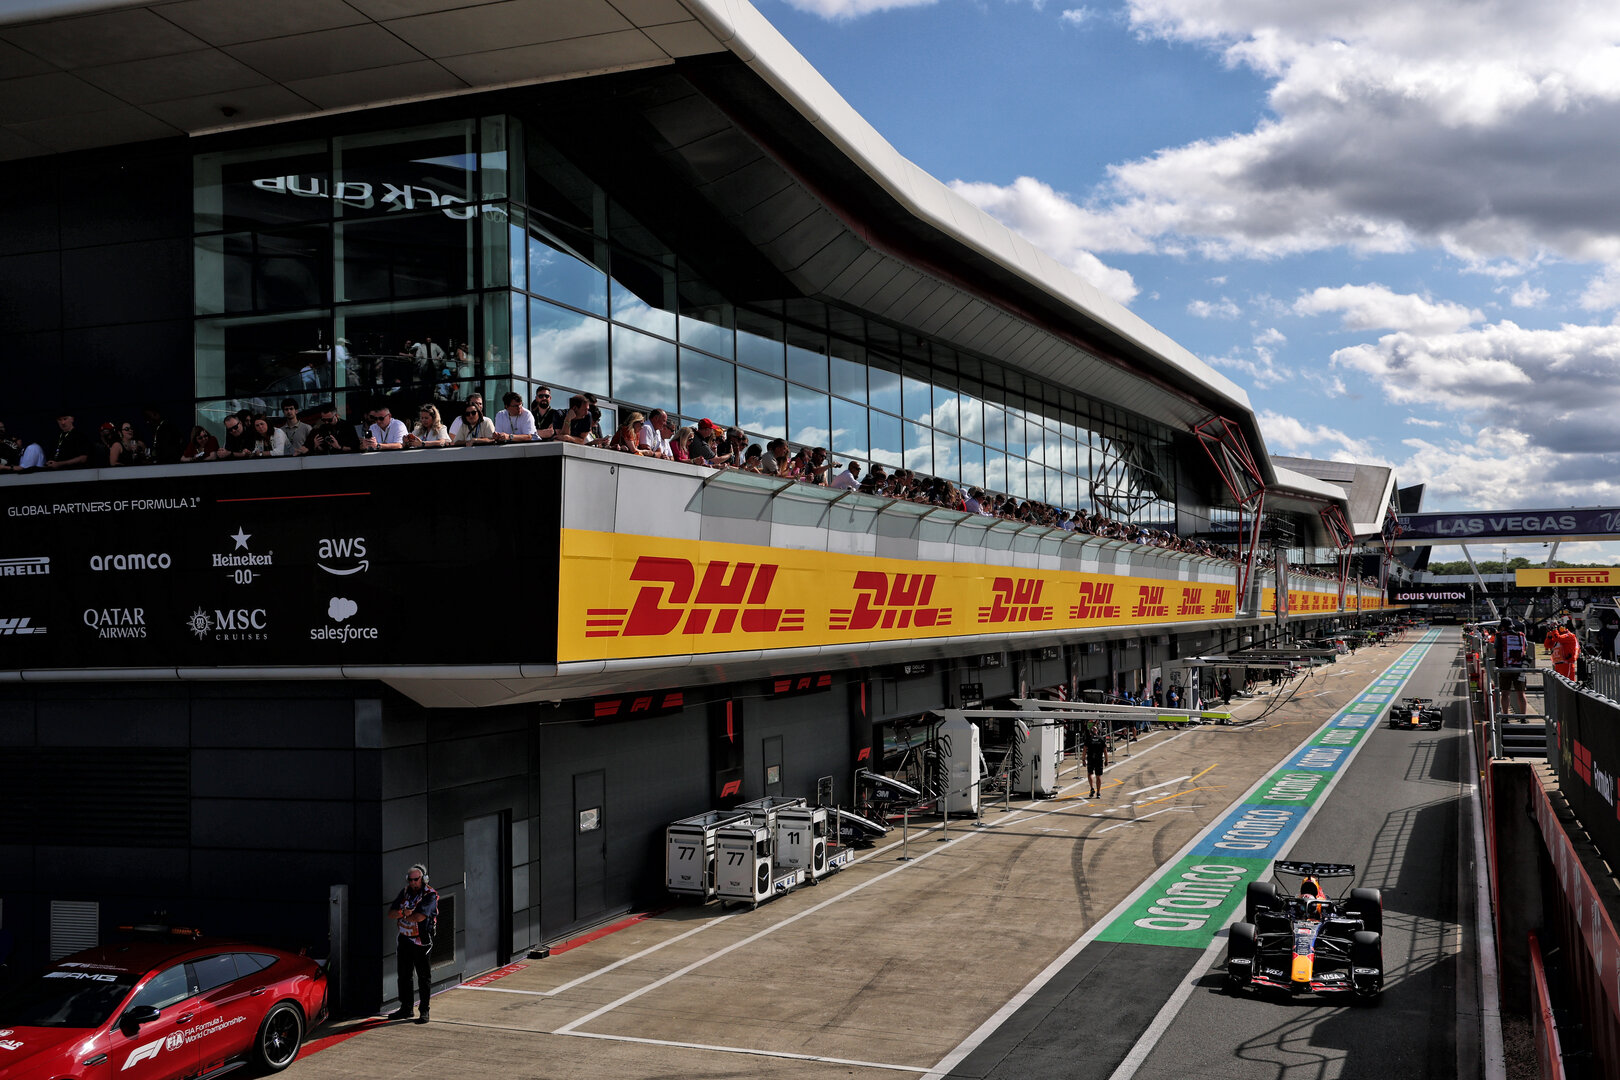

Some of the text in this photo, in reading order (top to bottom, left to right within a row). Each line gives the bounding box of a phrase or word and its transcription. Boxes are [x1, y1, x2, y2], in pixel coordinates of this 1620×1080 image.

[8, 505, 51, 517] GLOBAL
[53, 501, 111, 514] PARTNERS
[113, 500, 128, 511] OF
[131, 498, 188, 510] FORMULA
[1437, 516, 1577, 534] LAS VEGAS
[318, 537, 367, 559] aws
[90, 553, 171, 571] aramco
[1549, 571, 1609, 583] PIRELLI
[622, 556, 782, 636] DHL
[848, 571, 939, 630] DHL
[989, 577, 1044, 622] DHL
[1077, 582, 1114, 619] DHL
[1137, 586, 1164, 616] DHL
[1180, 588, 1201, 615] DHL
[1426, 592, 1466, 600] VUITTON
[83, 607, 145, 629] QATAR
[215, 609, 267, 630] MSC
[99, 626, 147, 639] AIRWAYS
[215, 633, 268, 641] CRUISES
[310, 624, 378, 643] salesforce
[788, 832, 800, 845] 11
[1213, 810, 1294, 850] aramco
[678, 846, 696, 860] 77
[726, 852, 745, 866] 77
[1133, 864, 1248, 931] aramco
[64, 972, 118, 982] AMG
[1319, 973, 1342, 981] VISA
[184, 1028, 195, 1037] FIA
[195, 1018, 220, 1033] Formula
[166, 1035, 183, 1048] FIA
[185, 1032, 203, 1044] World
[120, 1037, 166, 1071] F1
